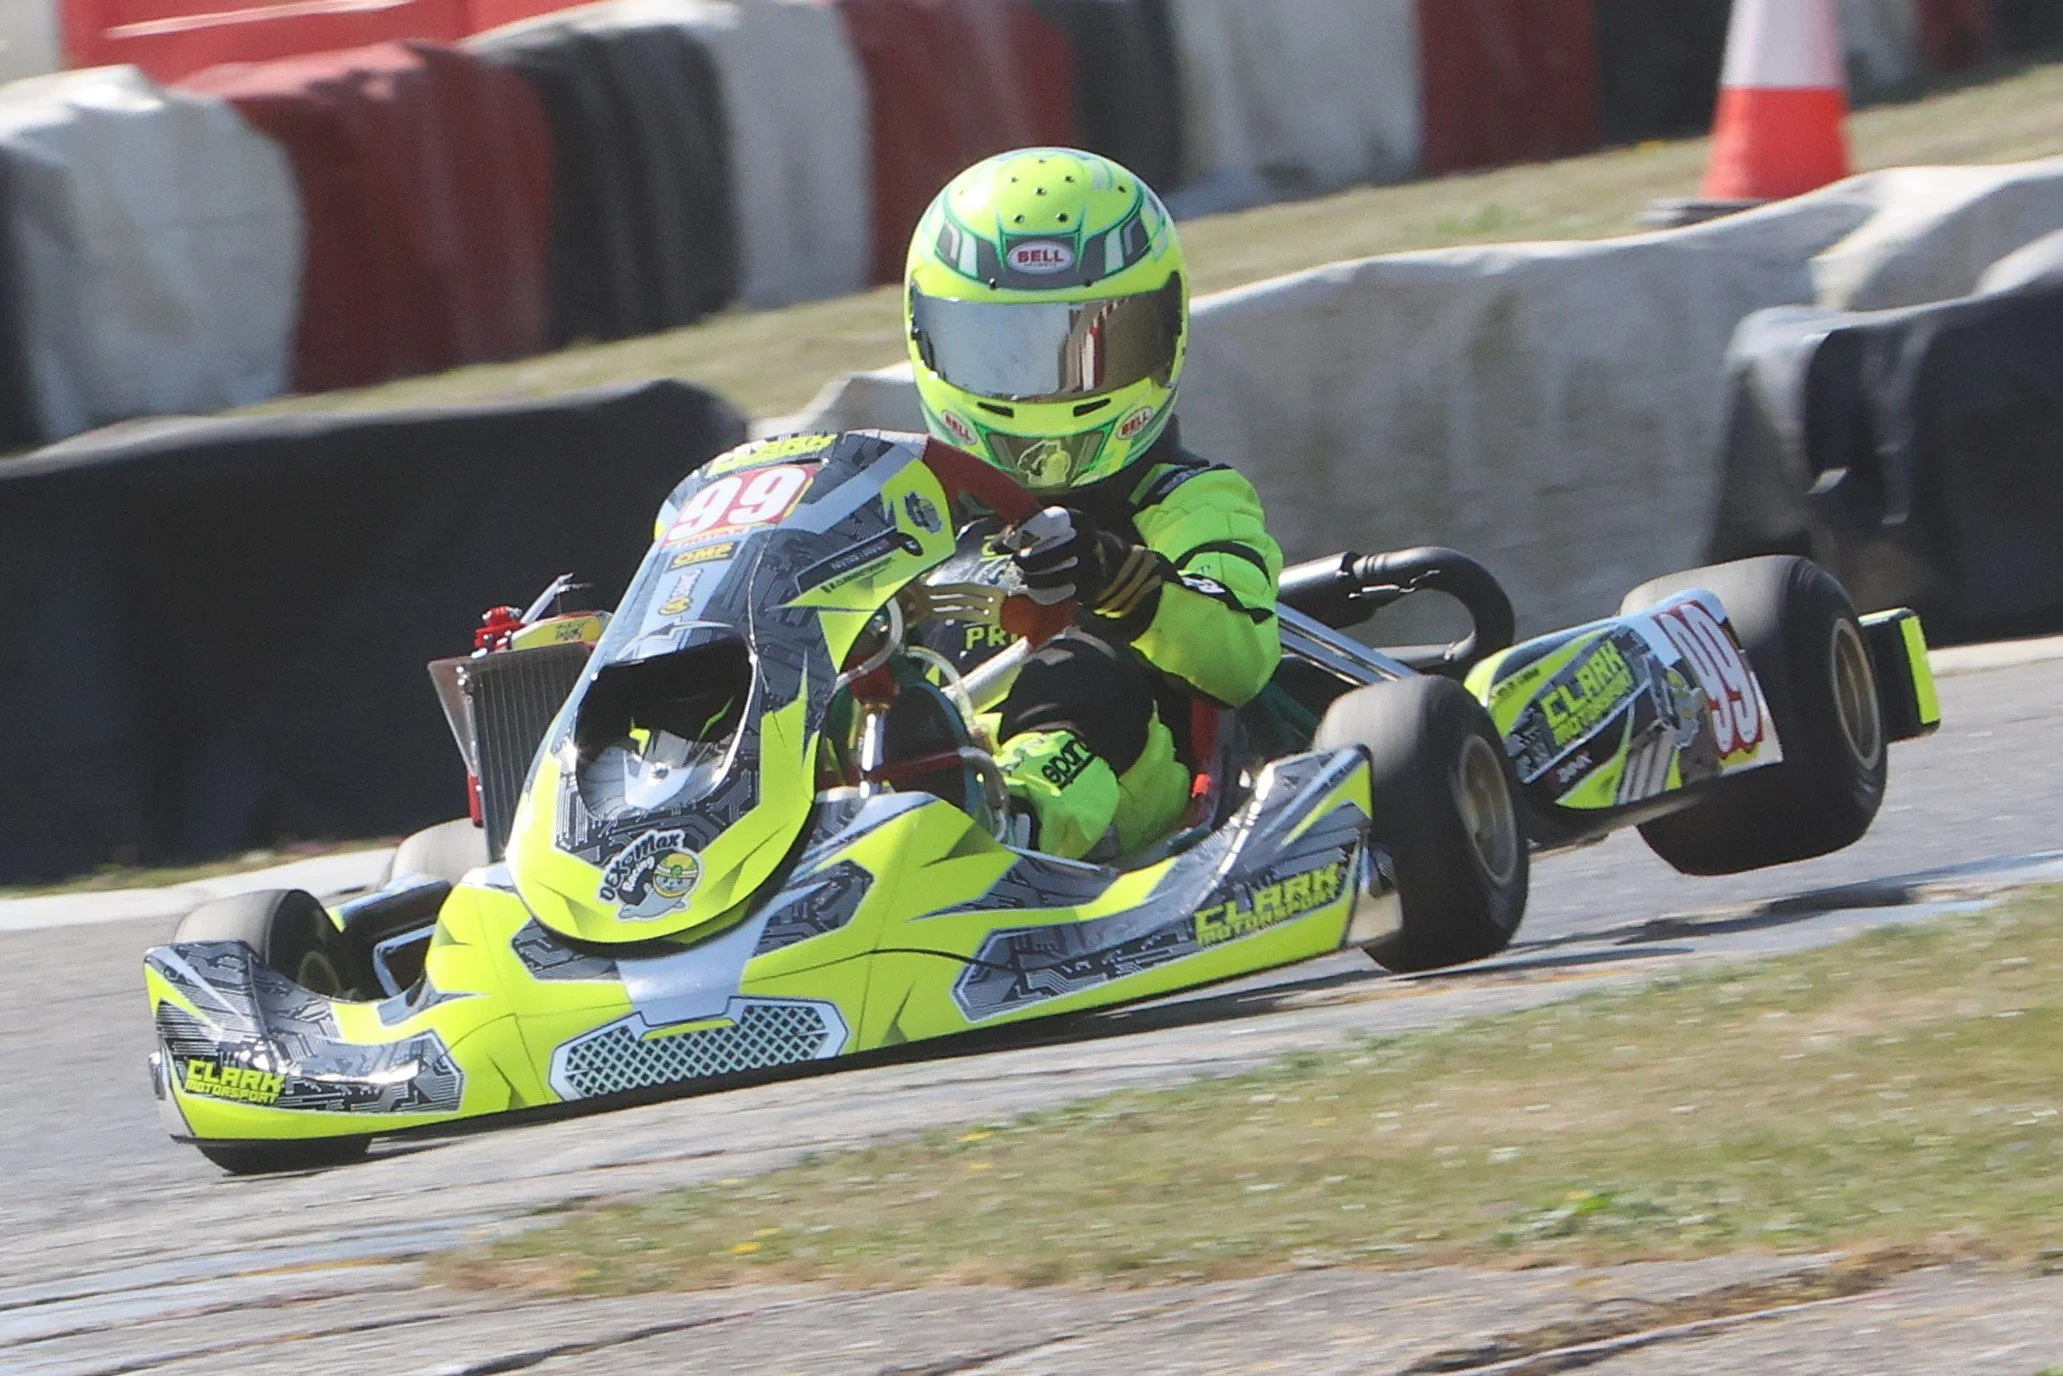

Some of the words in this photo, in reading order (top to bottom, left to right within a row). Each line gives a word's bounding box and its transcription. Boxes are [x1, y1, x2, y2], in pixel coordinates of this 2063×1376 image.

[1017, 248, 1065, 263] BELL
[1121, 410, 1149, 435] BELL
[667, 466, 807, 541] 99
[965, 624, 1020, 650] PR
[1540, 639, 1628, 728] CLARK
[1658, 603, 1760, 753] 99
[1194, 863, 1340, 930] CLARK
[185, 1078, 280, 1105] MOTORSPORT
[187, 1058, 286, 1093] CLARK
